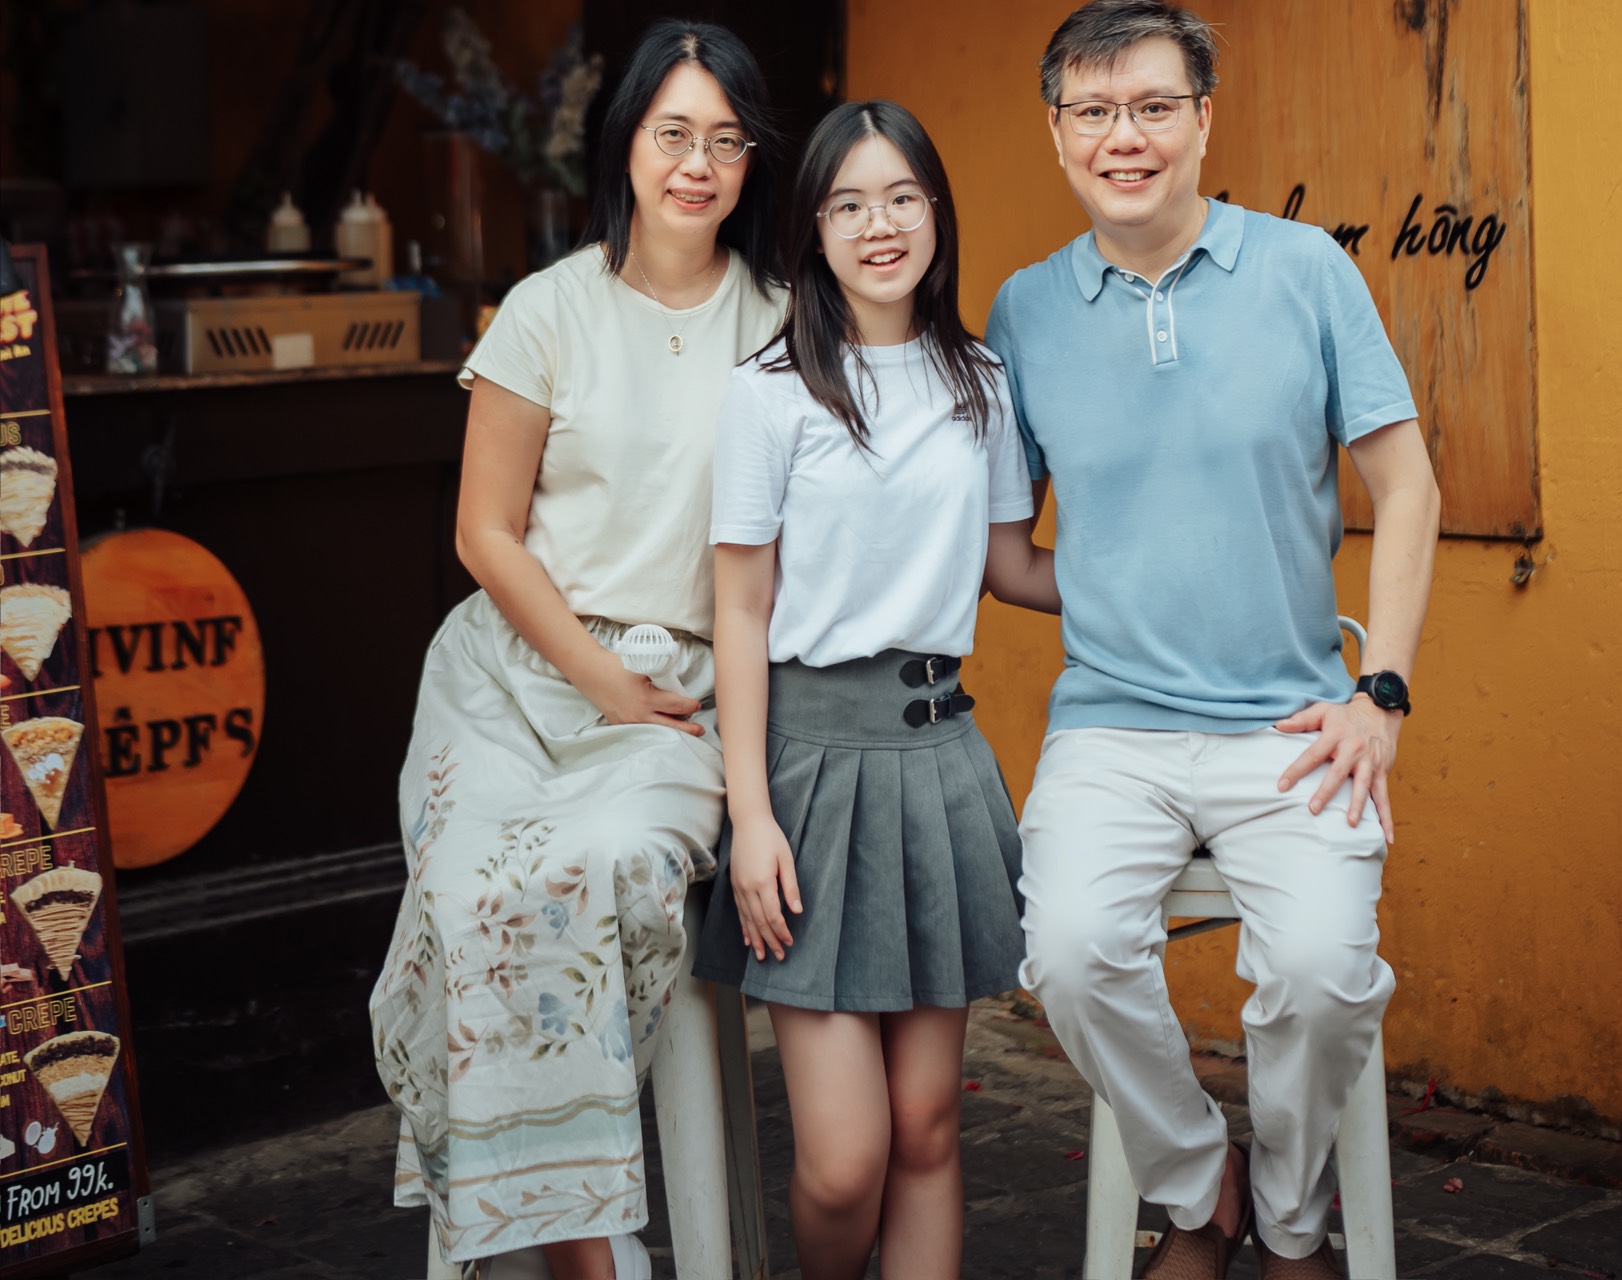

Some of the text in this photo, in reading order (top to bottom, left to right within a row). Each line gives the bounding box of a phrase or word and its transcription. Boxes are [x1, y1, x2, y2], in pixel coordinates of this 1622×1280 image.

[8, 996, 77, 1035] CREPE
[0, 1197, 119, 1249] DELICIOUS CREPES
